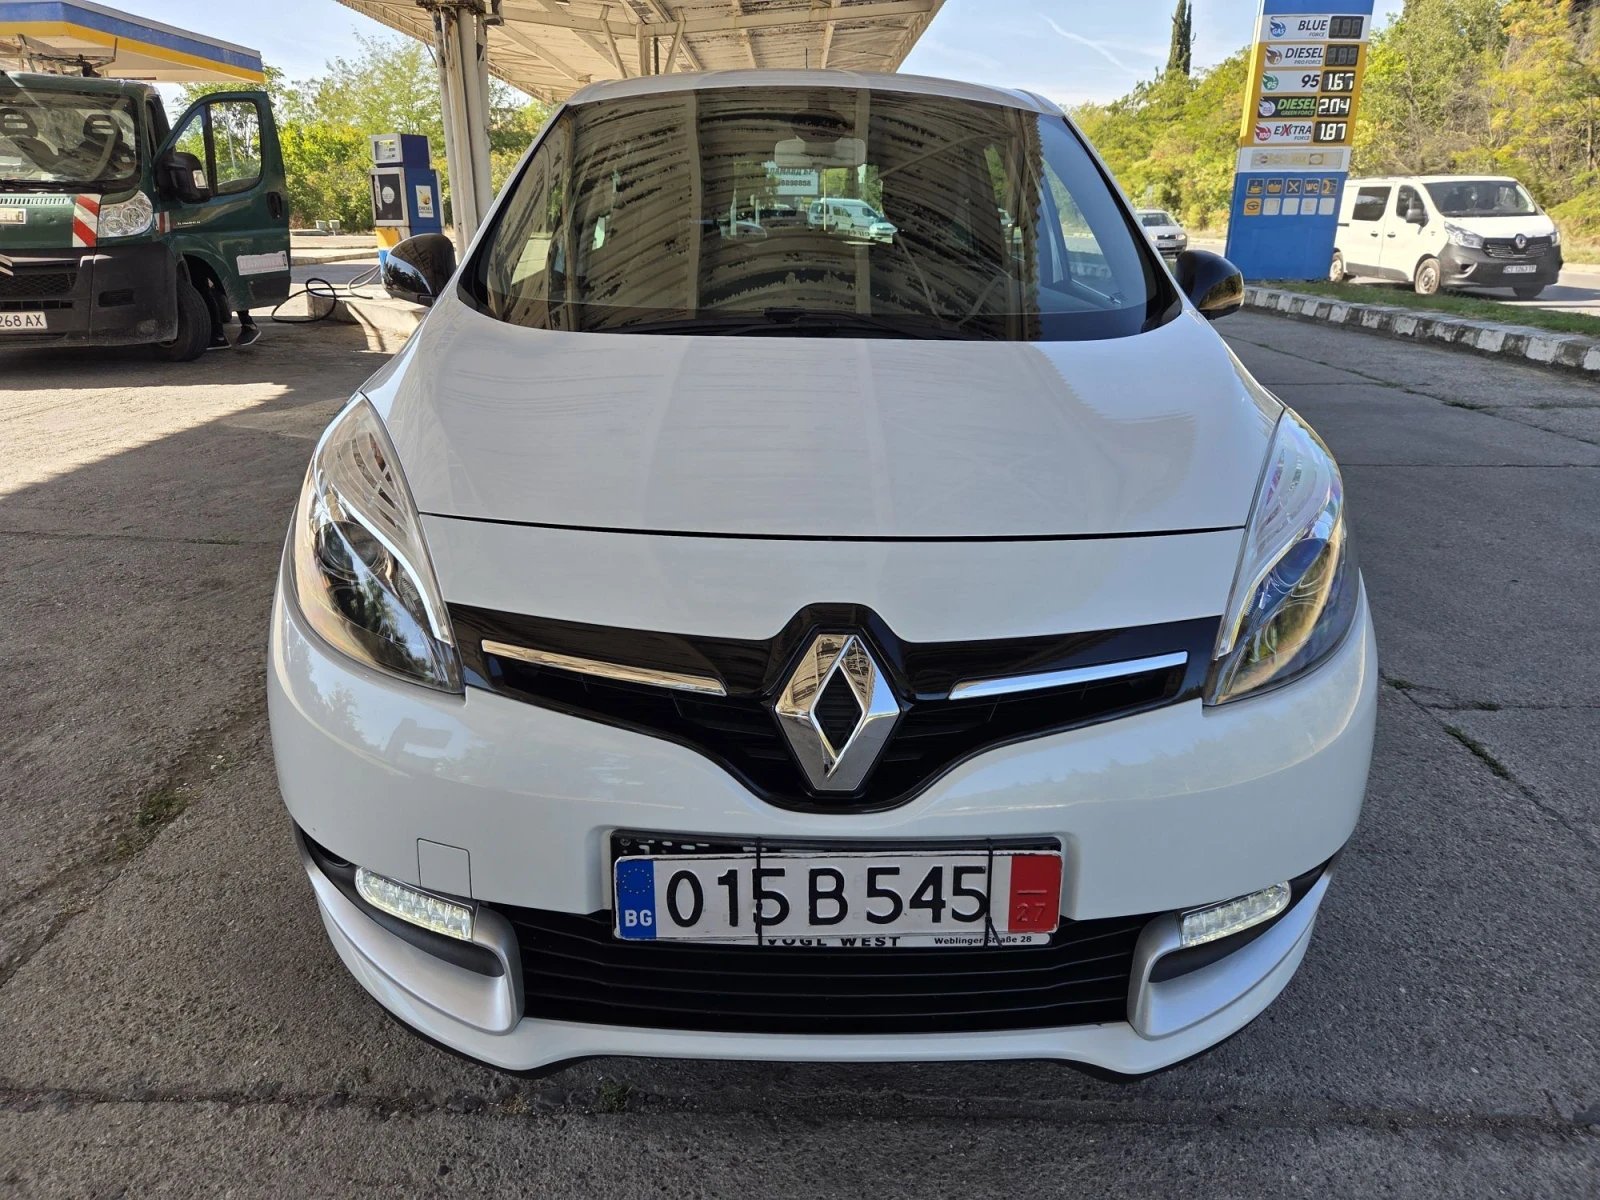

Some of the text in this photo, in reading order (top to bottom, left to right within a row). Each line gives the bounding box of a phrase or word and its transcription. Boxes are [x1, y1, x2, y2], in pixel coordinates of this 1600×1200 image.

[1298, 20, 1328, 31] BLUE
[1285, 48, 1324, 58] DIESEL
[1301, 74, 1321, 88] 95
[1277, 99, 1316, 109] DIESEL
[1318, 98, 1351, 114] 2.04
[1320, 123, 1347, 141] 1.87
[1305, 182, 1319, 191] WC
[26, 314, 44, 327] AX
[666, 866, 988, 928] 015 B 545
[625, 910, 652, 927] BG
[1016, 903, 1046, 922] 27
[840, 936, 901, 947] WEST
[934, 937, 984, 946] Weblinger
[987, 936, 1018, 944] Staße
